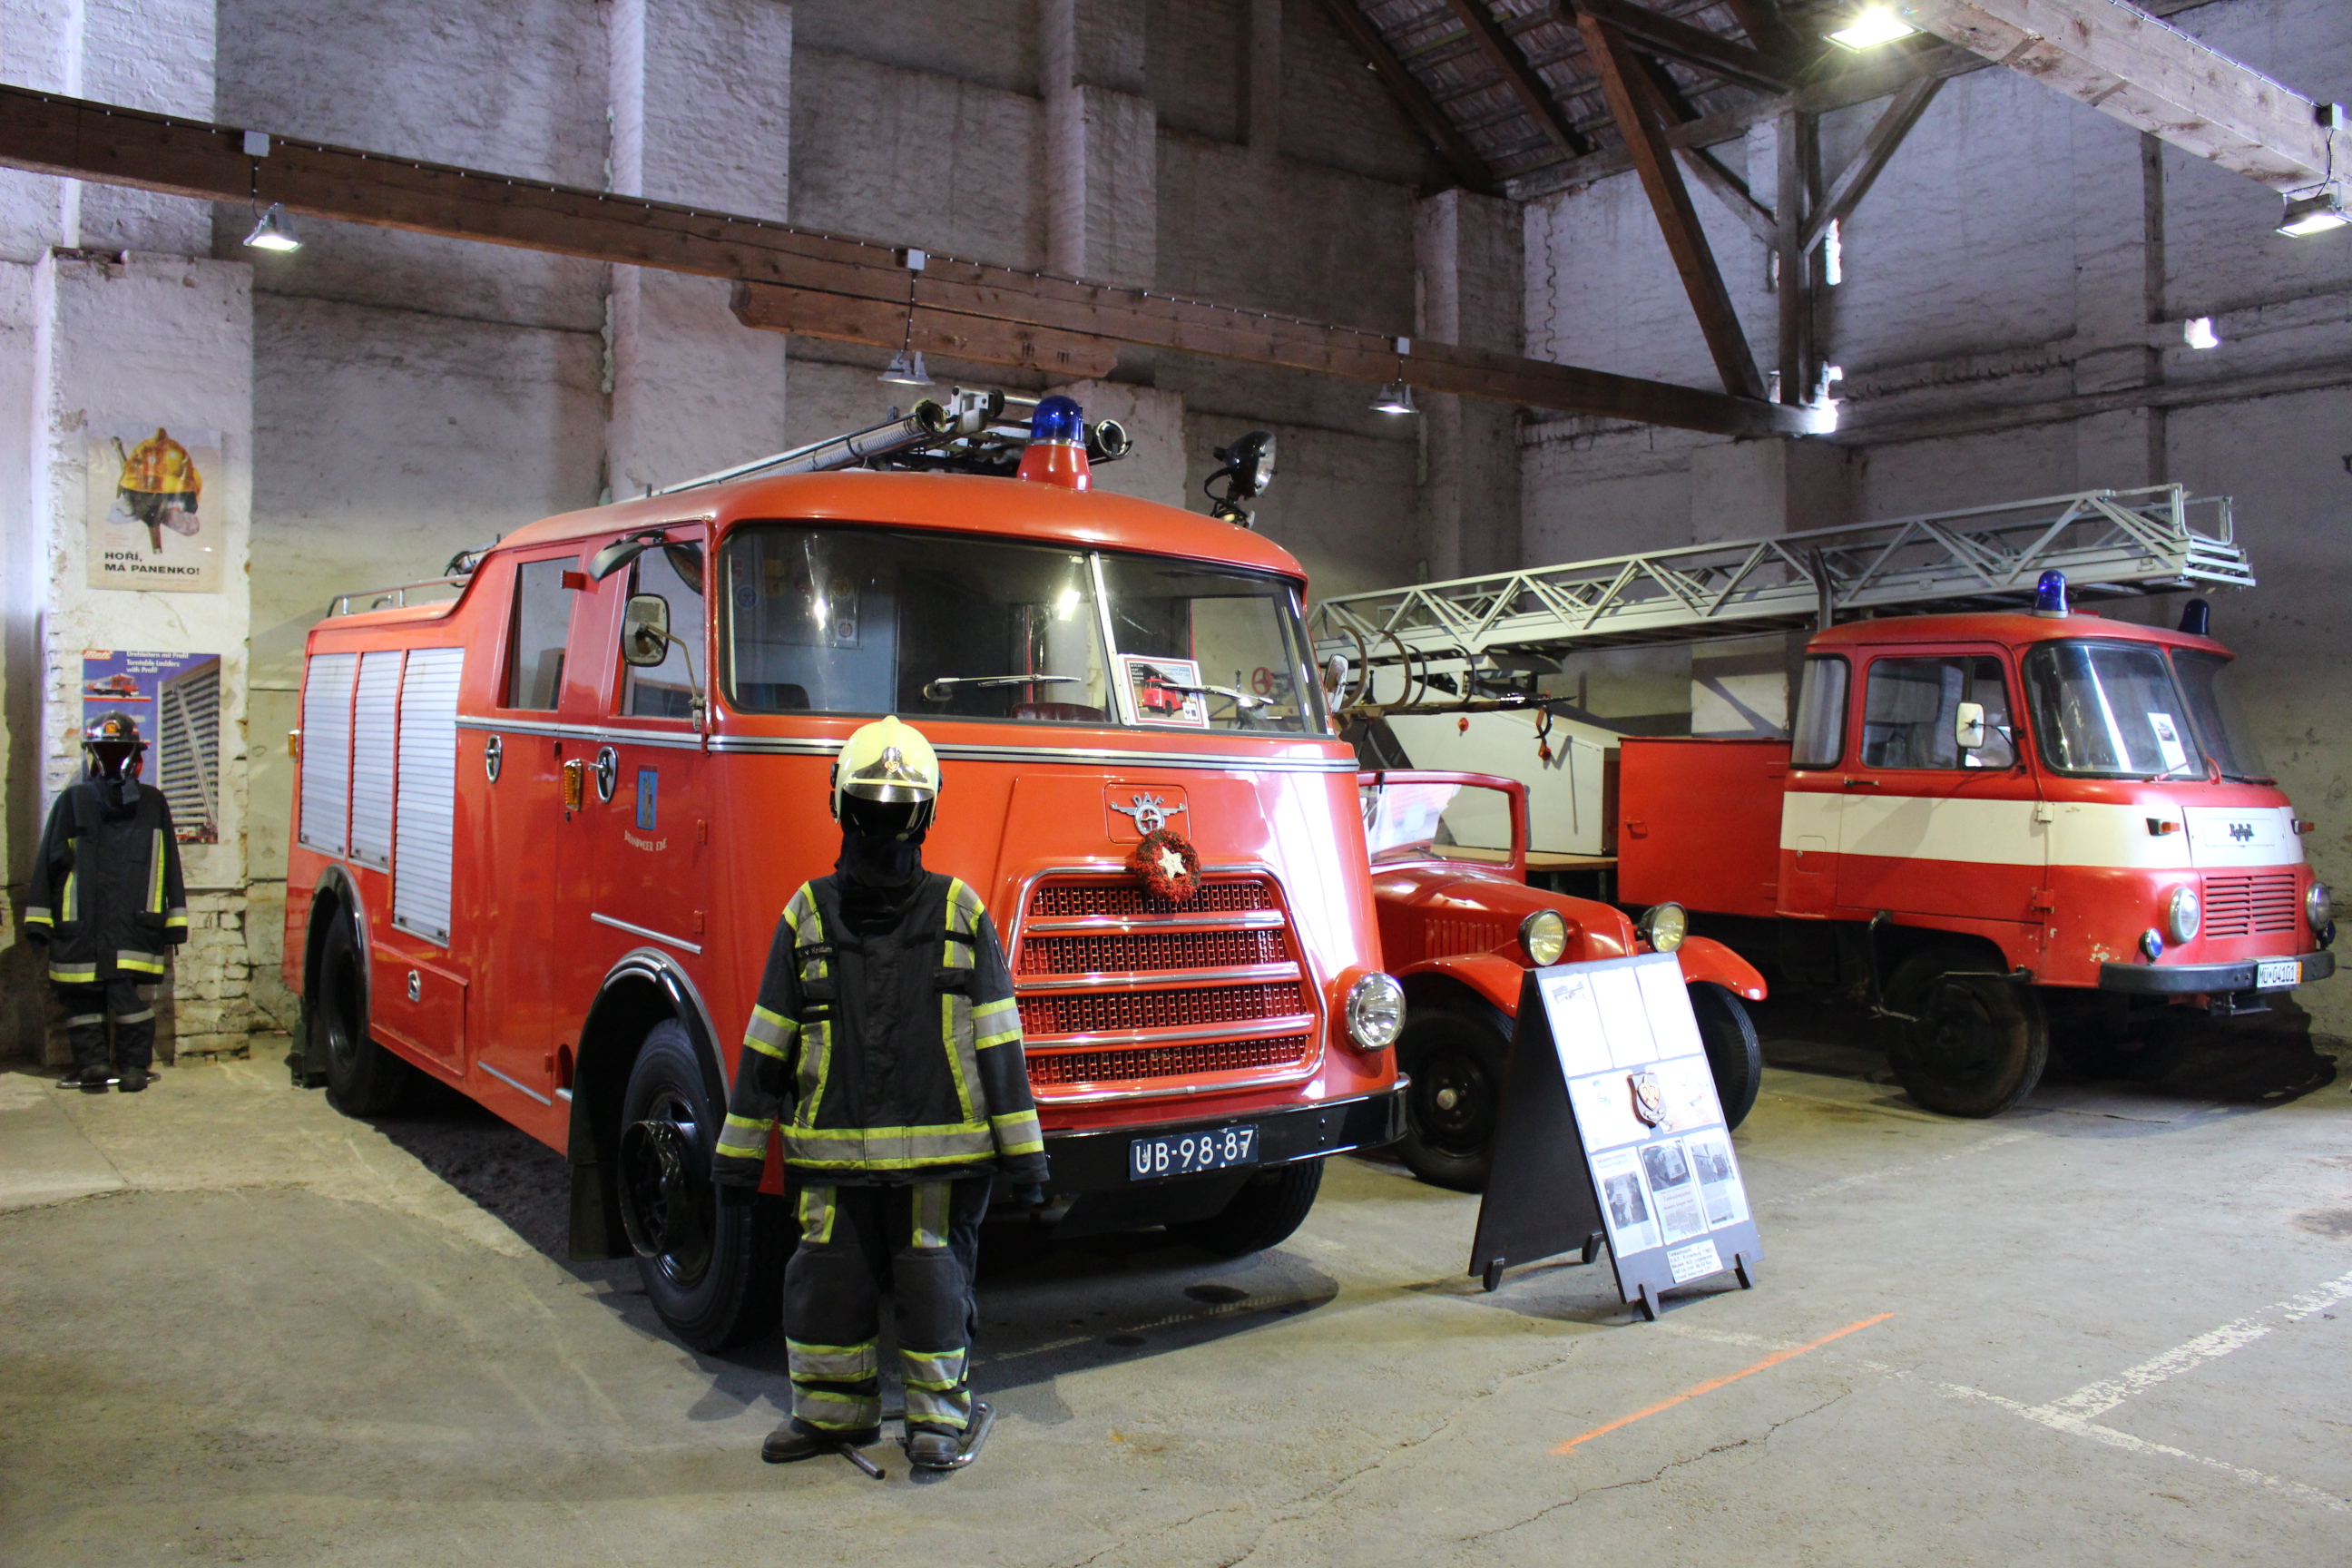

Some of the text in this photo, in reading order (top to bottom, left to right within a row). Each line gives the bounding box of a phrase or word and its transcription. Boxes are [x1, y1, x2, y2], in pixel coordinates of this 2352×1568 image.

[104, 551, 142, 562] HOŘÍ,
[104, 563, 200, 575] MÁ PANENKO!
[126, 659, 155, 667] Turntable
[1132, 791, 1165, 807] DAF
[1136, 1129, 1254, 1173] UB-98-87
